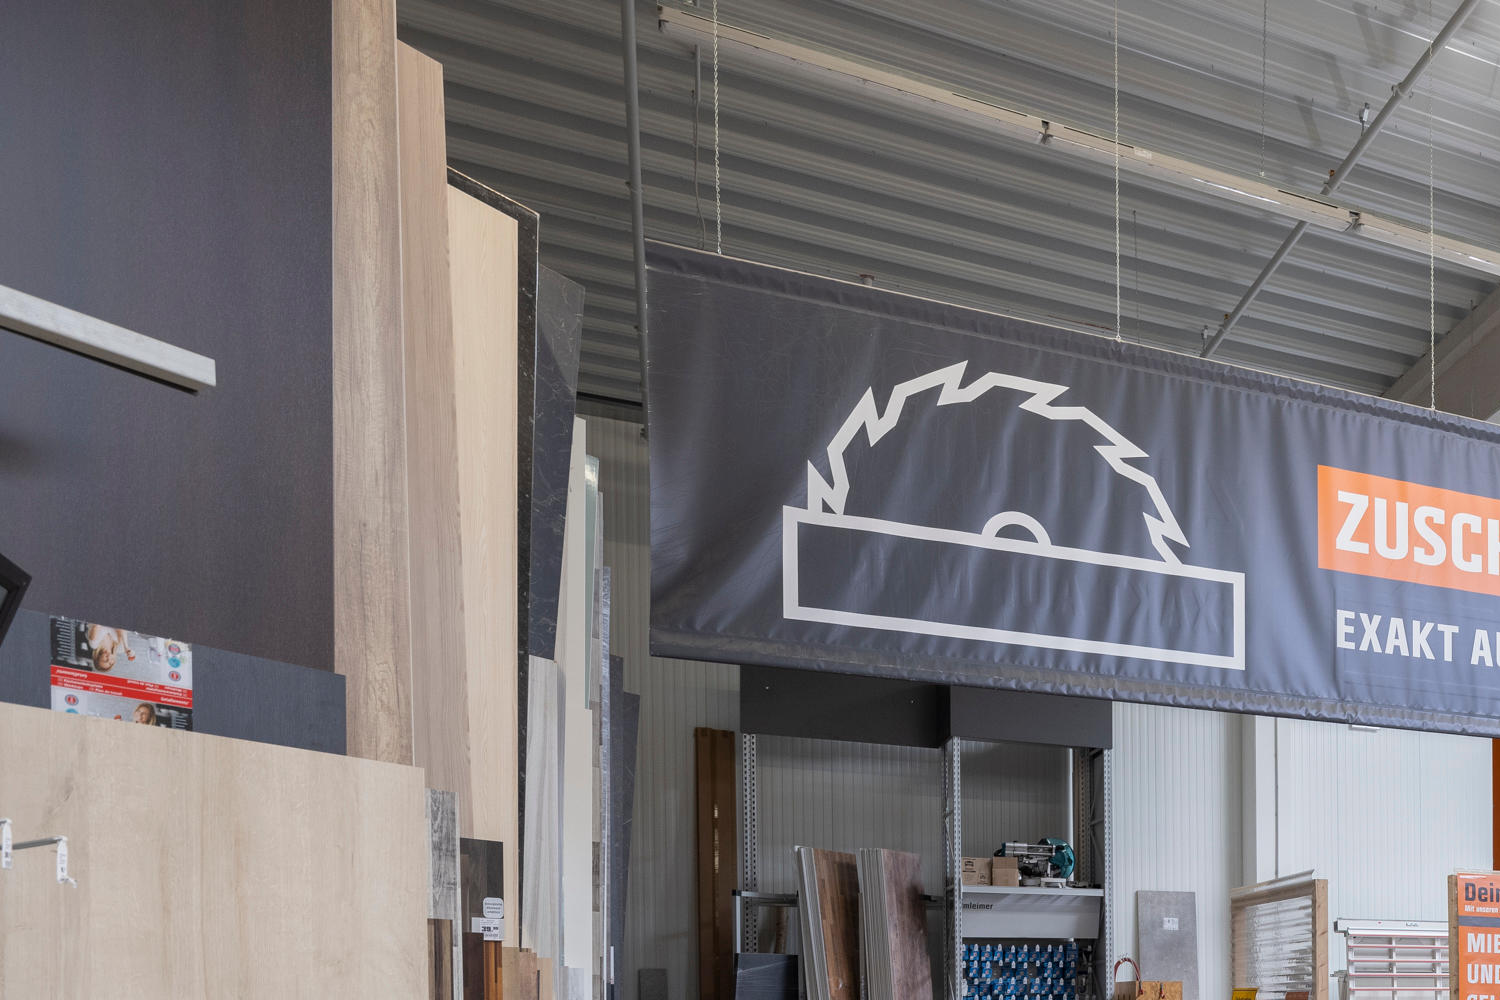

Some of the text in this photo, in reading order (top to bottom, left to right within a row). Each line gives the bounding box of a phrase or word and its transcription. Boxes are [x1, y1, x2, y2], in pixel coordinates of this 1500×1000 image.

[1336, 609, 1459, 662] EXAKT
[962, 902, 993, 910] mleimer
[1464, 905, 1475, 913] Mit
